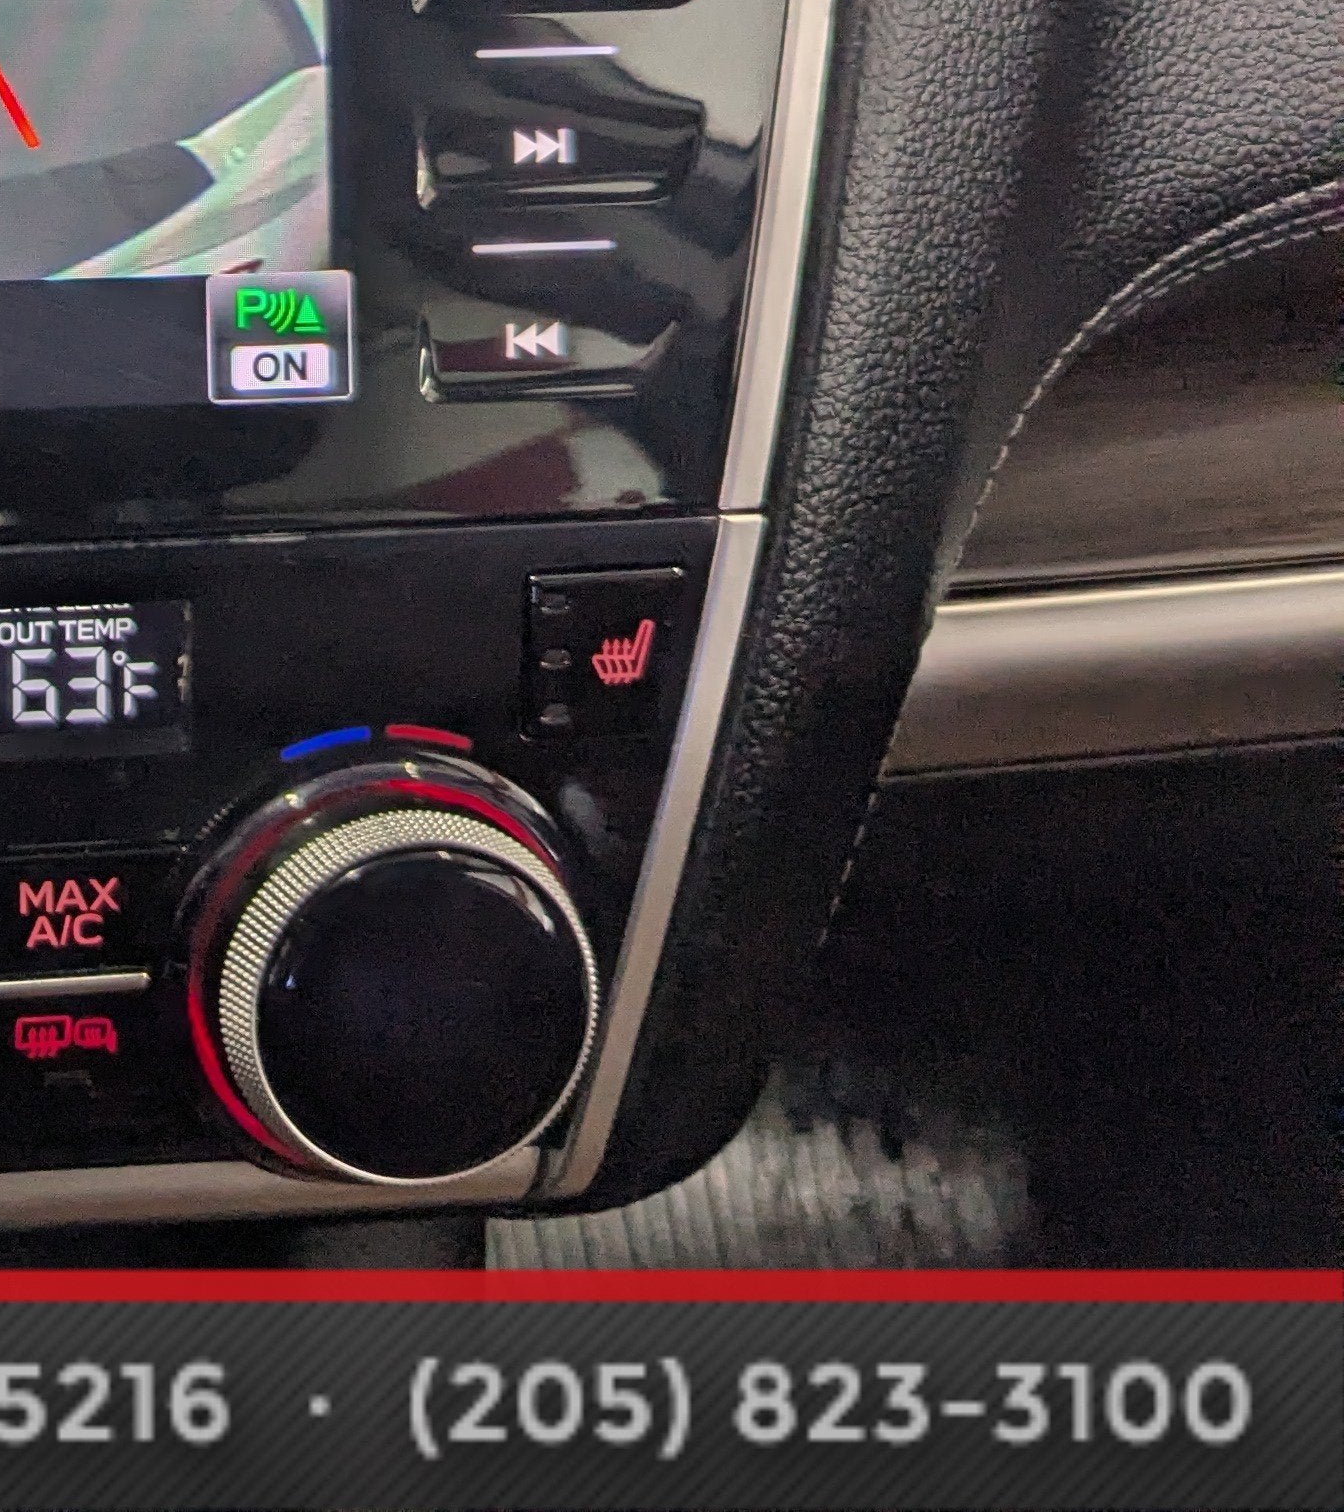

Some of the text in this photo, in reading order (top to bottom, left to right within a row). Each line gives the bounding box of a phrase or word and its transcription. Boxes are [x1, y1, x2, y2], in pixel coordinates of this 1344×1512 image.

[253, 351, 308, 382] ON
[58, 617, 138, 642] TEMP
[18, 876, 121, 916] MAX
[26, 913, 105, 949] A/C
